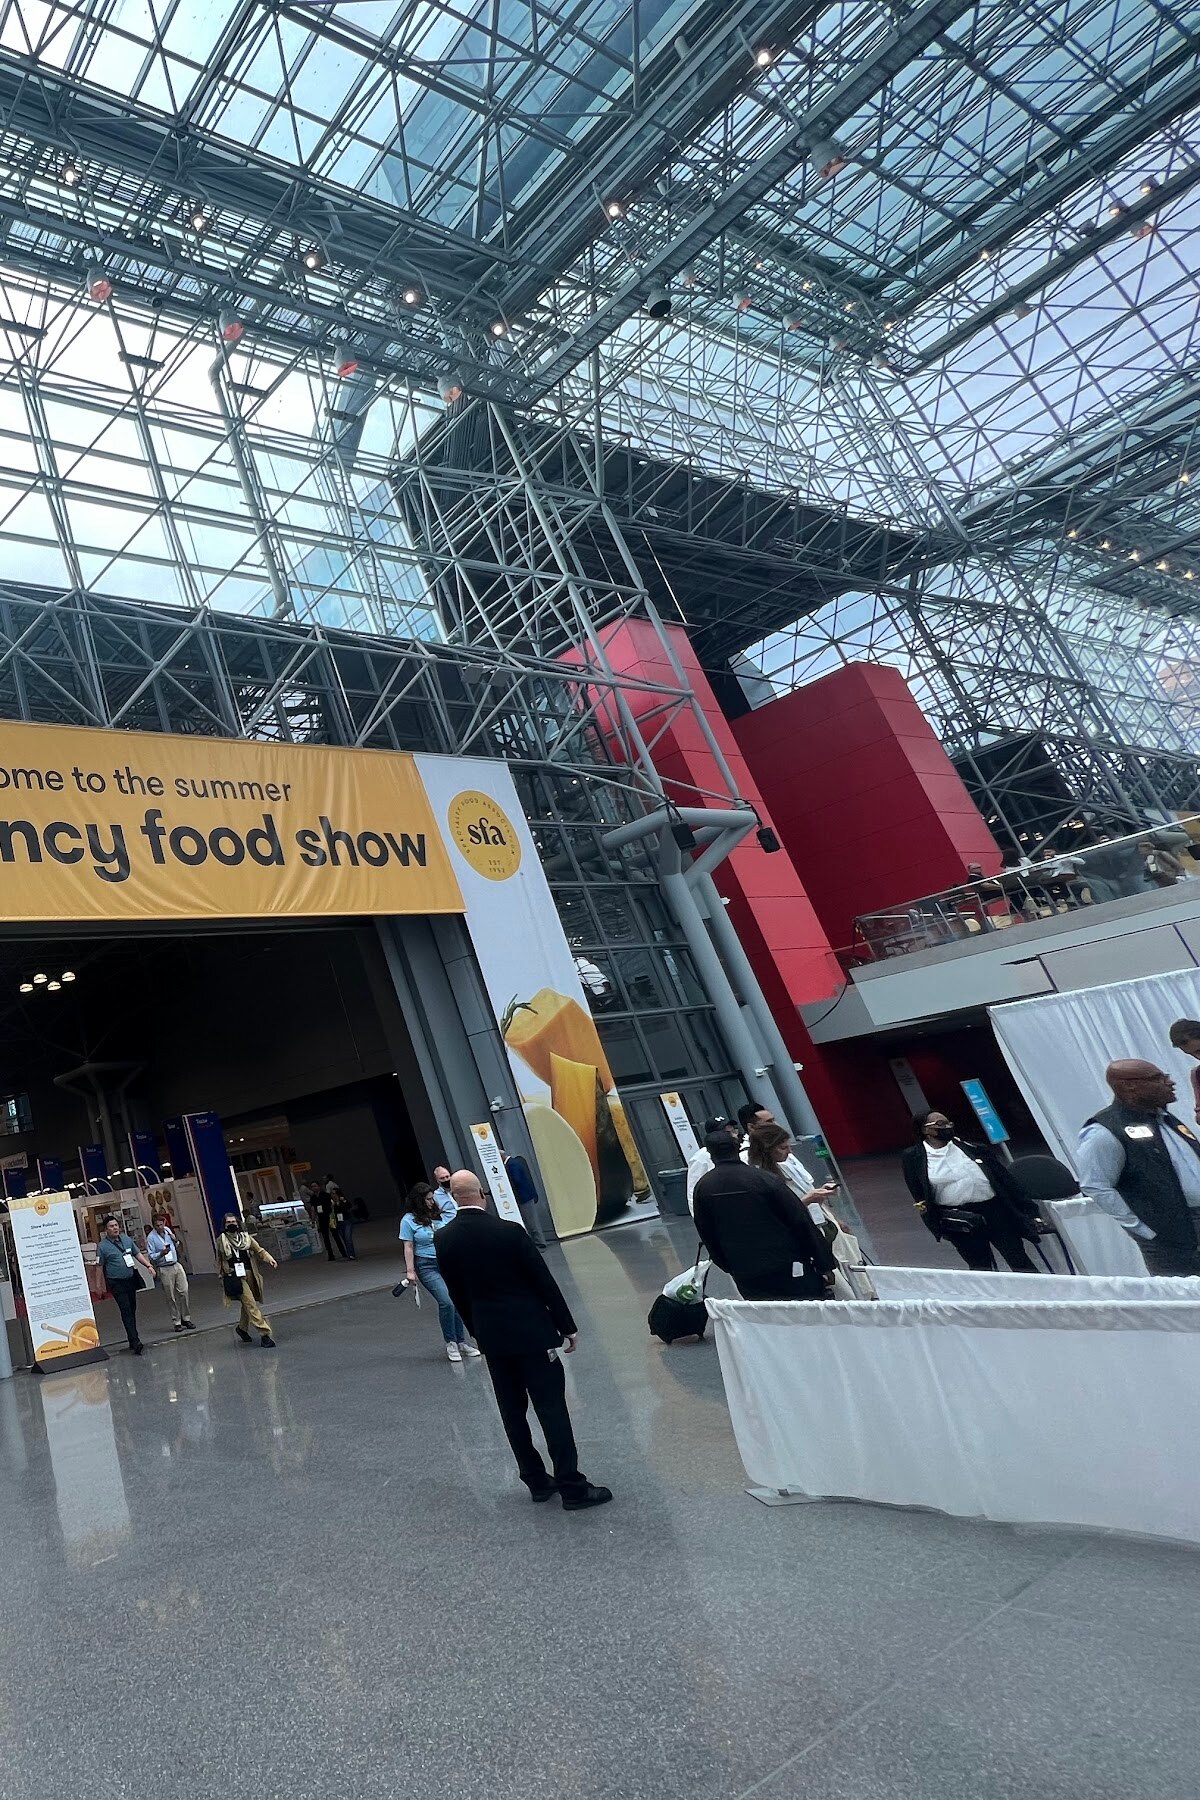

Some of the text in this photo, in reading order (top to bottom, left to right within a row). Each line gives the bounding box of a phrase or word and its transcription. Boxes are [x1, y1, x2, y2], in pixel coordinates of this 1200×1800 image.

[71, 766, 107, 794] to
[112, 766, 165, 797] the
[174, 777, 292, 802] summer
[140, 808, 286, 867] food
[295, 815, 427, 867] show
[467, 817, 507, 846] sfa
